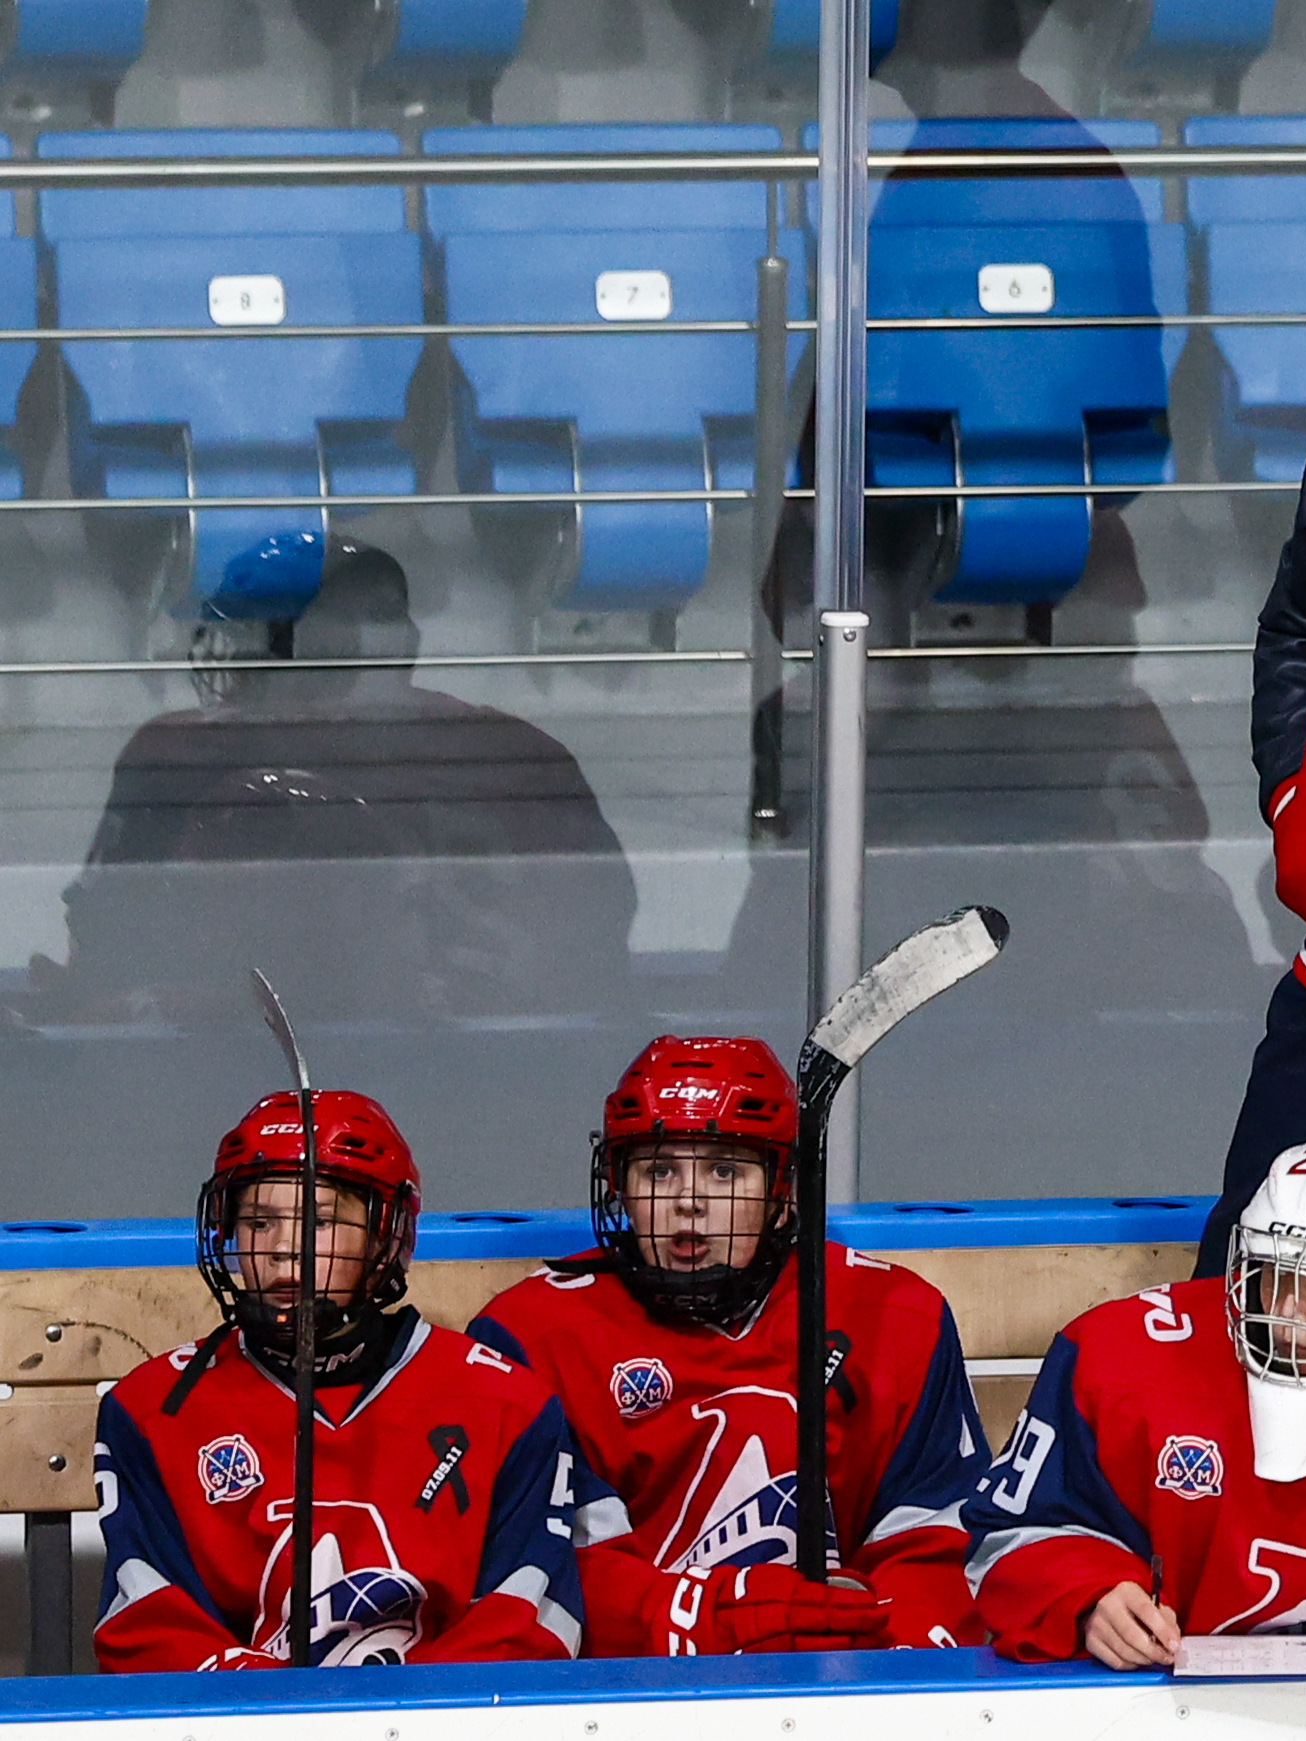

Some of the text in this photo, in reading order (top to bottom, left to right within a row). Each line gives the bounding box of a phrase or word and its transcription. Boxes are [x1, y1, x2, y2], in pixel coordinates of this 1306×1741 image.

[626, 286, 639, 305] 7
[1008, 279, 1021, 298] 6
[421, 1446, 463, 1501] 07.09.11
